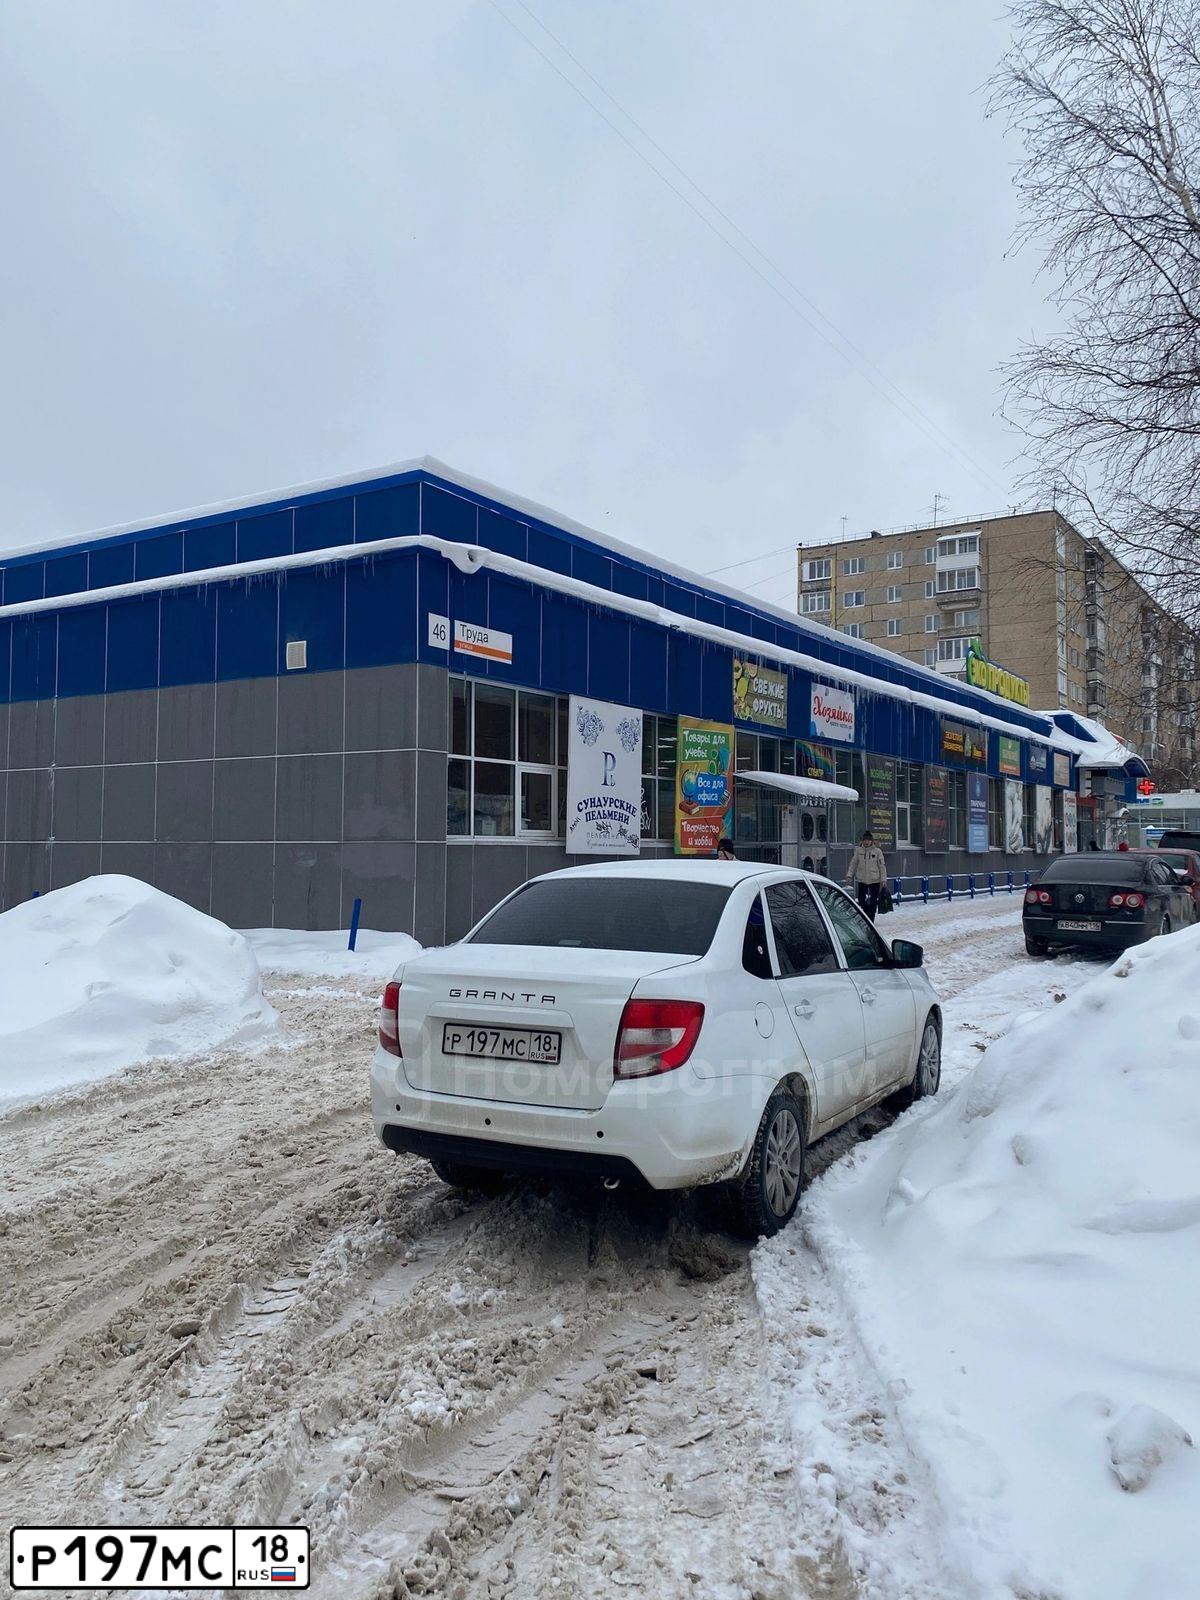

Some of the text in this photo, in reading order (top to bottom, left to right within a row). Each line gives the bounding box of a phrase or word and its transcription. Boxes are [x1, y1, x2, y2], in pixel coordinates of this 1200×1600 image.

[432, 623, 447, 641] 46
[459, 624, 489, 644] Труда
[752, 678, 785, 699] СВЕЖИЕ
[752, 698, 784, 719] ФРУКТЫ
[813, 696, 853, 723] Хозяйка
[683, 730, 726, 746] Товары для
[685, 747, 708, 760] учебы
[697, 776, 724, 789] Все для
[697, 791, 718, 804] офиса
[577, 797, 638, 817] СУНДУРСКИЕ
[585, 810, 630, 825] ПЕЛЬМЕНИ
[682, 821, 720, 836] Творчество
[688, 835, 713, 846] и хобби
[449, 989, 556, 1004] GRANTA
[451, 1030, 552, 1056] Р197МС 18
[530, 1051, 545, 1059] RUS
